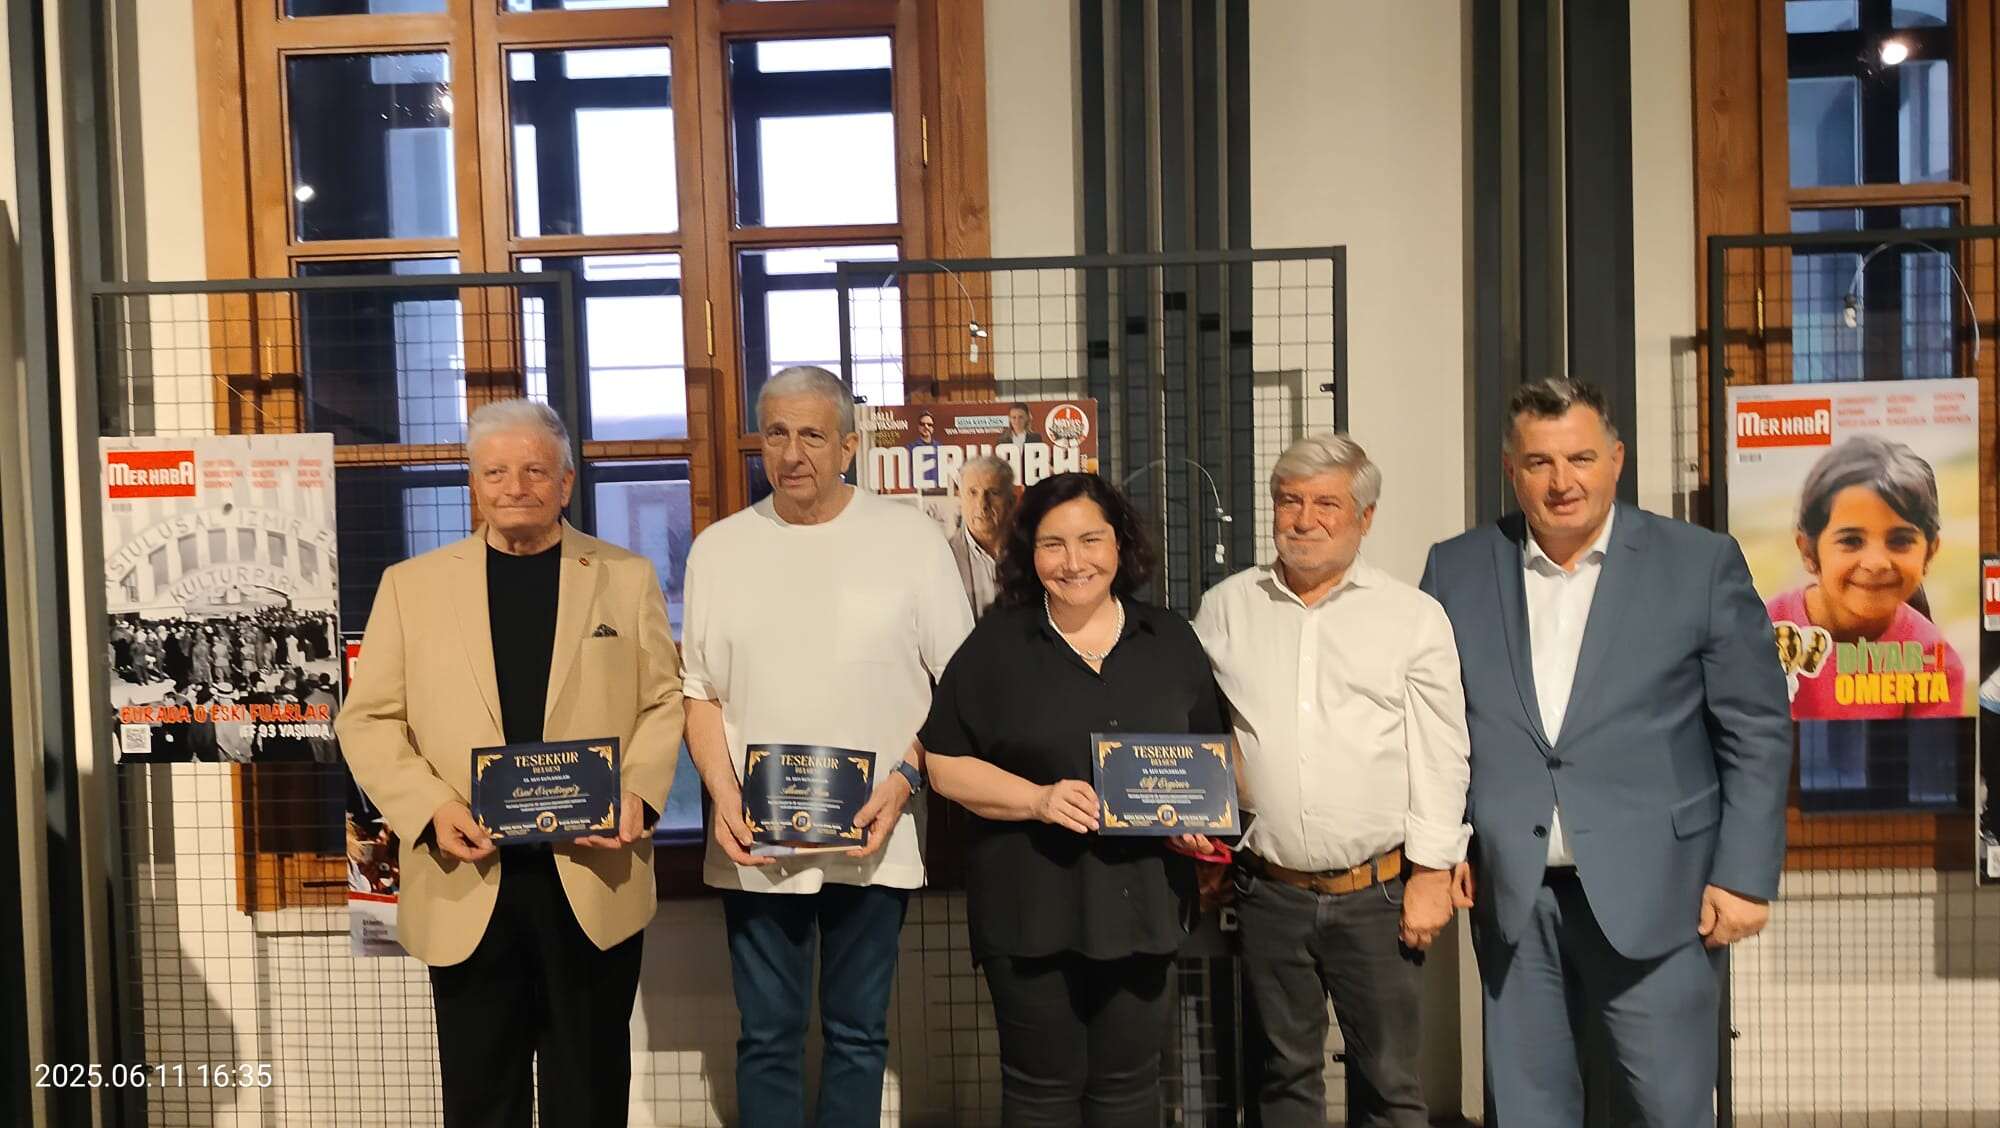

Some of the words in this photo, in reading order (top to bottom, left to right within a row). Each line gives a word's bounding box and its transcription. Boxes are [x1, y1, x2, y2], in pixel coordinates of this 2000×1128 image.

[1737, 408, 1831, 437] MERHABA
[109, 461, 194, 486] MERHABA
[1835, 671, 1950, 705] OMERTA
[194, 703, 207, 723] O
[249, 702, 330, 723] FUARLAR
[259, 724, 276, 738] 93
